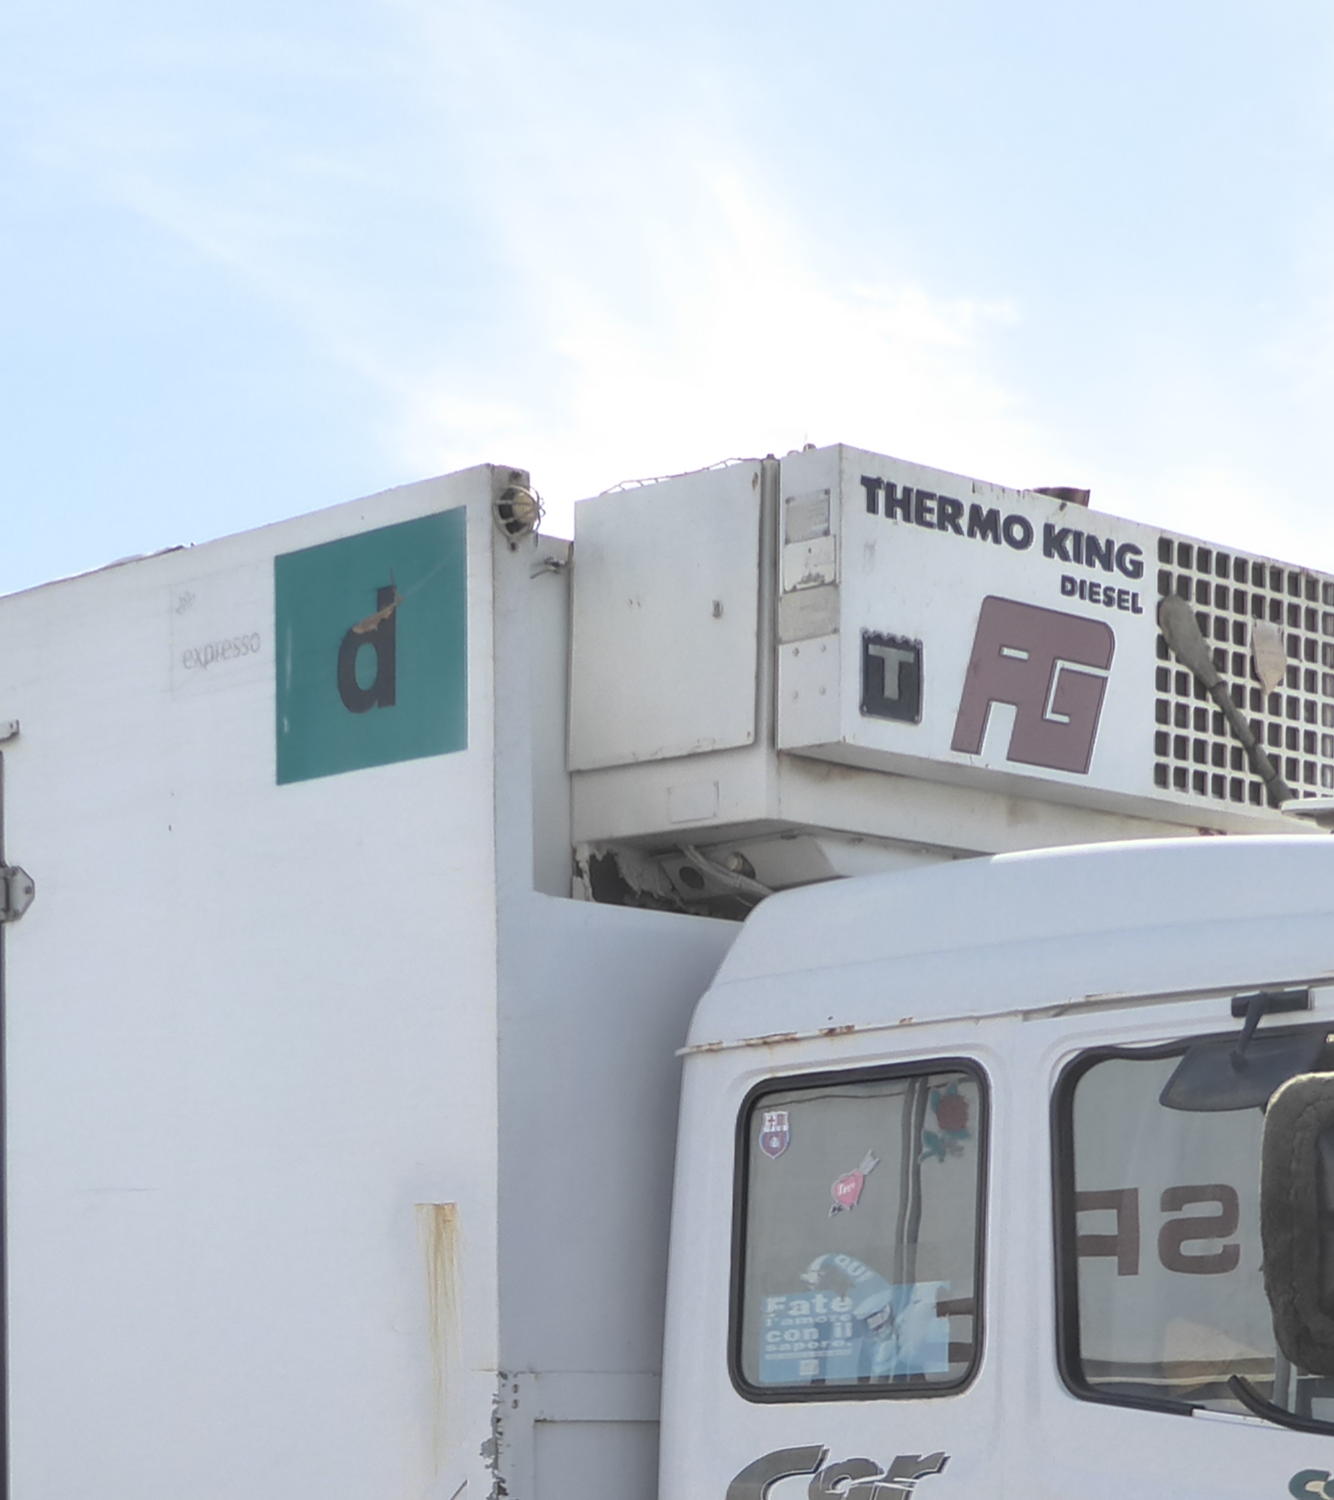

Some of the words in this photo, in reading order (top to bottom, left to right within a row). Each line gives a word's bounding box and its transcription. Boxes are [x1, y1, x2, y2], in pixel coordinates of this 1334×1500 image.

[860, 475, 1034, 551] THERMO
[1043, 523, 1144, 580] KING
[1061, 574, 1144, 614] DIESEL
[337, 585, 397, 714] d
[766, 1293, 854, 1317] Fate
[765, 1327, 820, 1343] con
[832, 1321, 853, 1339] il
